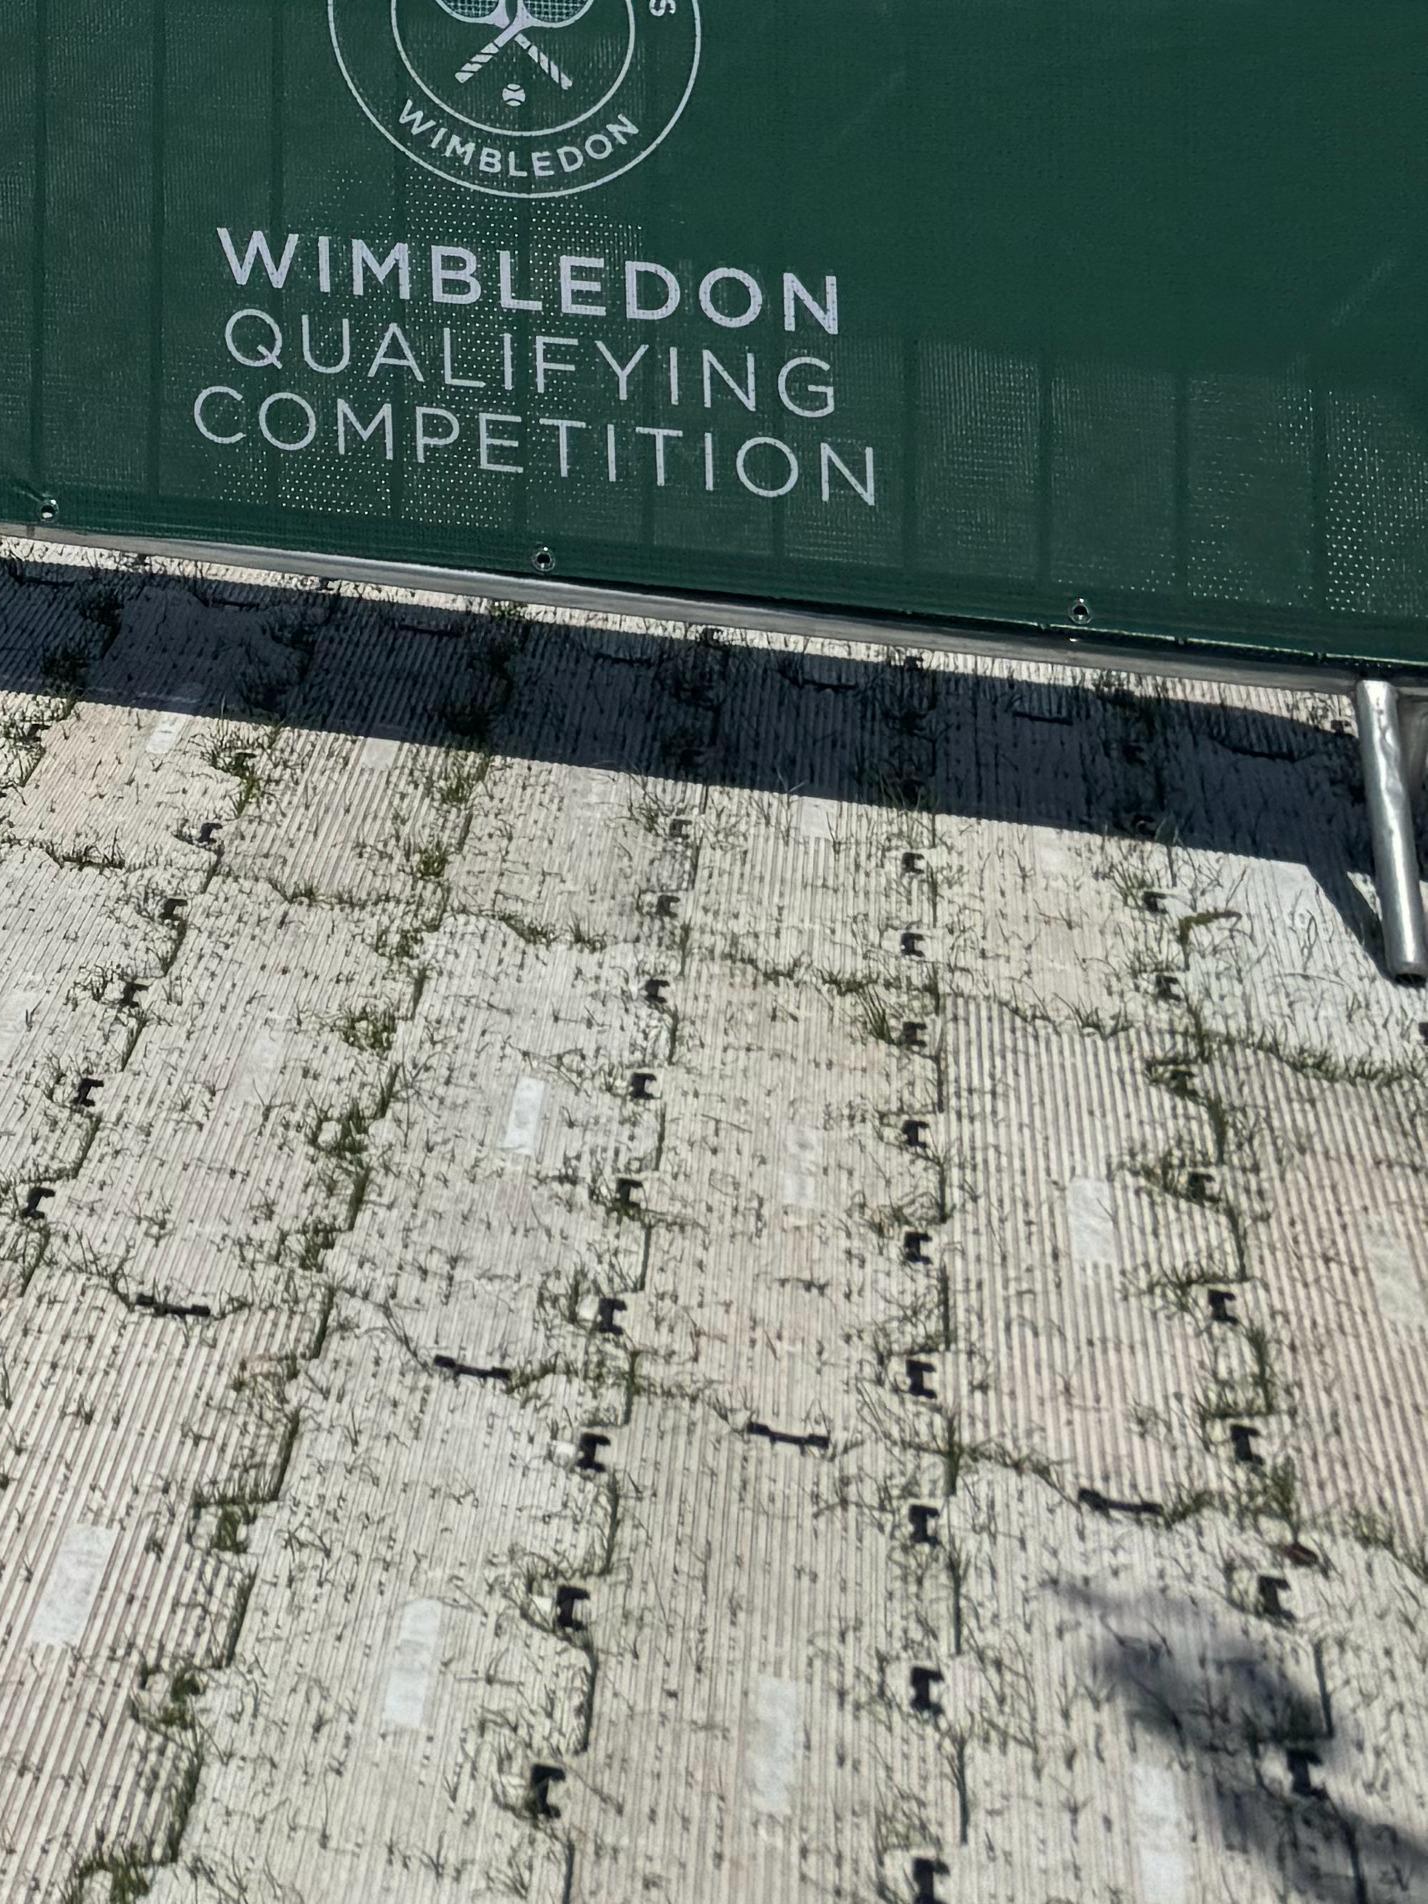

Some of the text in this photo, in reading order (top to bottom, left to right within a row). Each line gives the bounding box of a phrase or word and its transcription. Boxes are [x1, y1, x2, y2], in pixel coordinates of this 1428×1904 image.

[398, 98, 640, 178] WIMBLEDON
[216, 226, 840, 335] WIMBLEDON
[224, 308, 836, 419] QUALIFYING
[193, 385, 876, 507] COMPETITION
